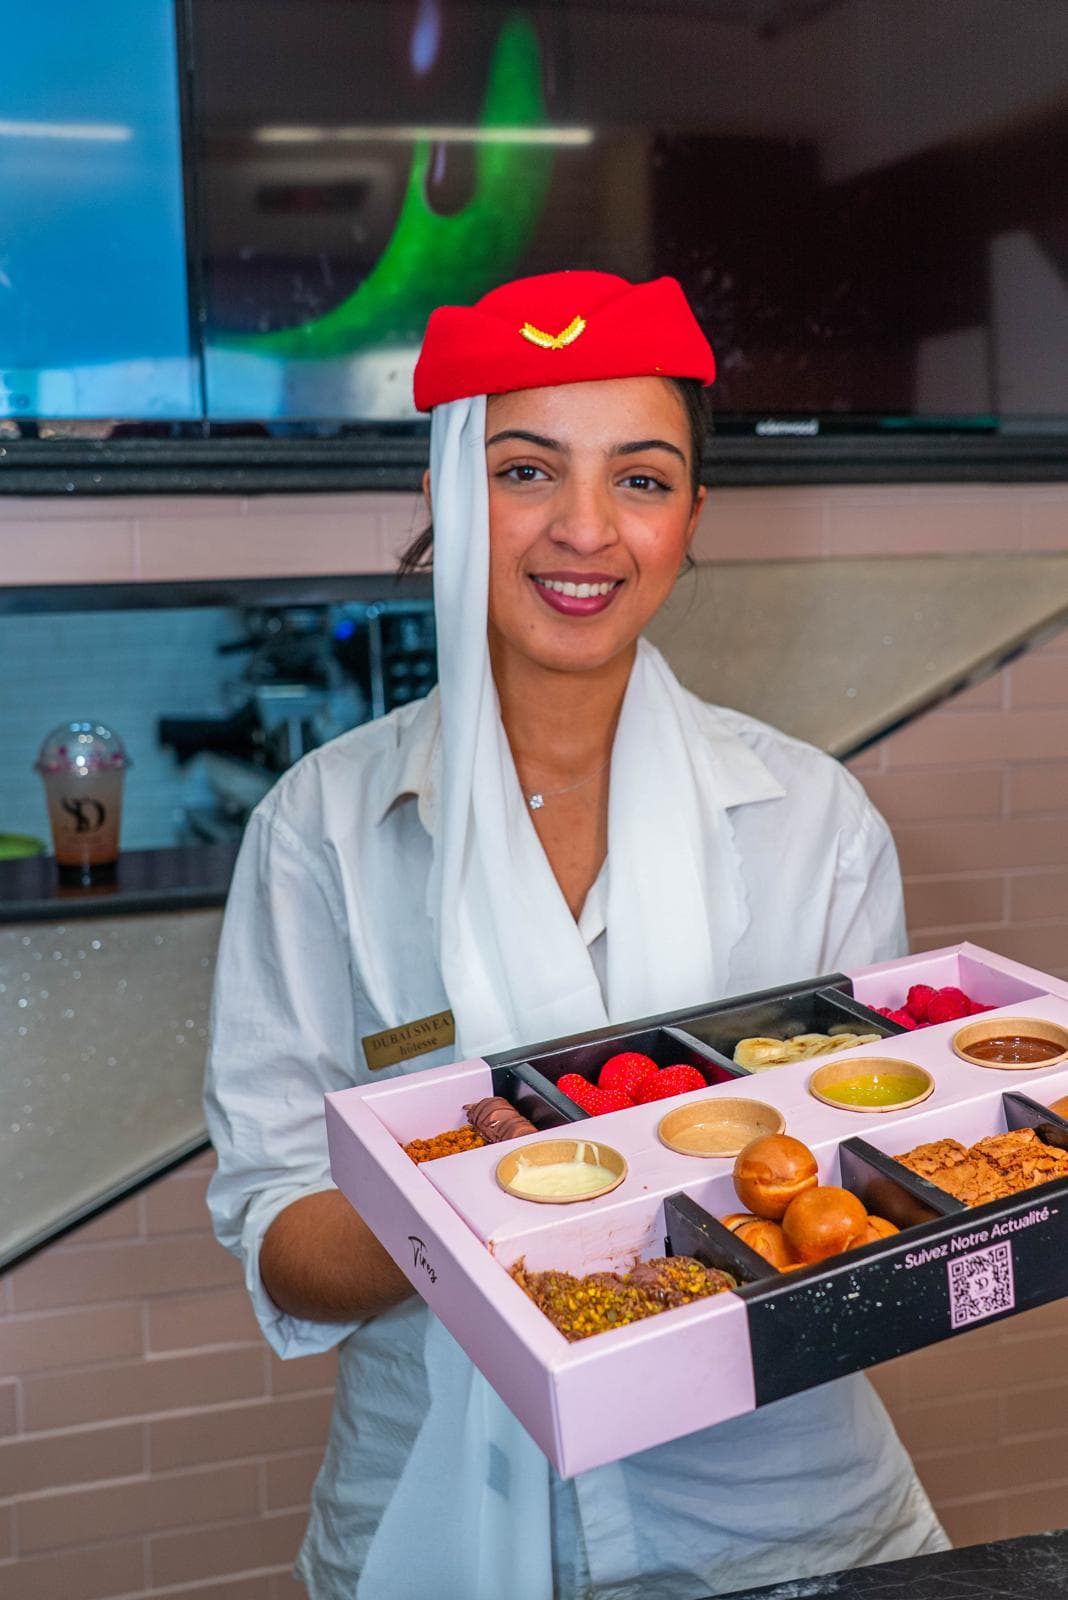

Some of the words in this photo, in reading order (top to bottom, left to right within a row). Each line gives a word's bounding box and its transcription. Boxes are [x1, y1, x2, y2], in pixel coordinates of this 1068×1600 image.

[905, 1245, 949, 1269] Suivez
[951, 1230, 989, 1253] Notre
[990, 1206, 1049, 1239] Actualité
